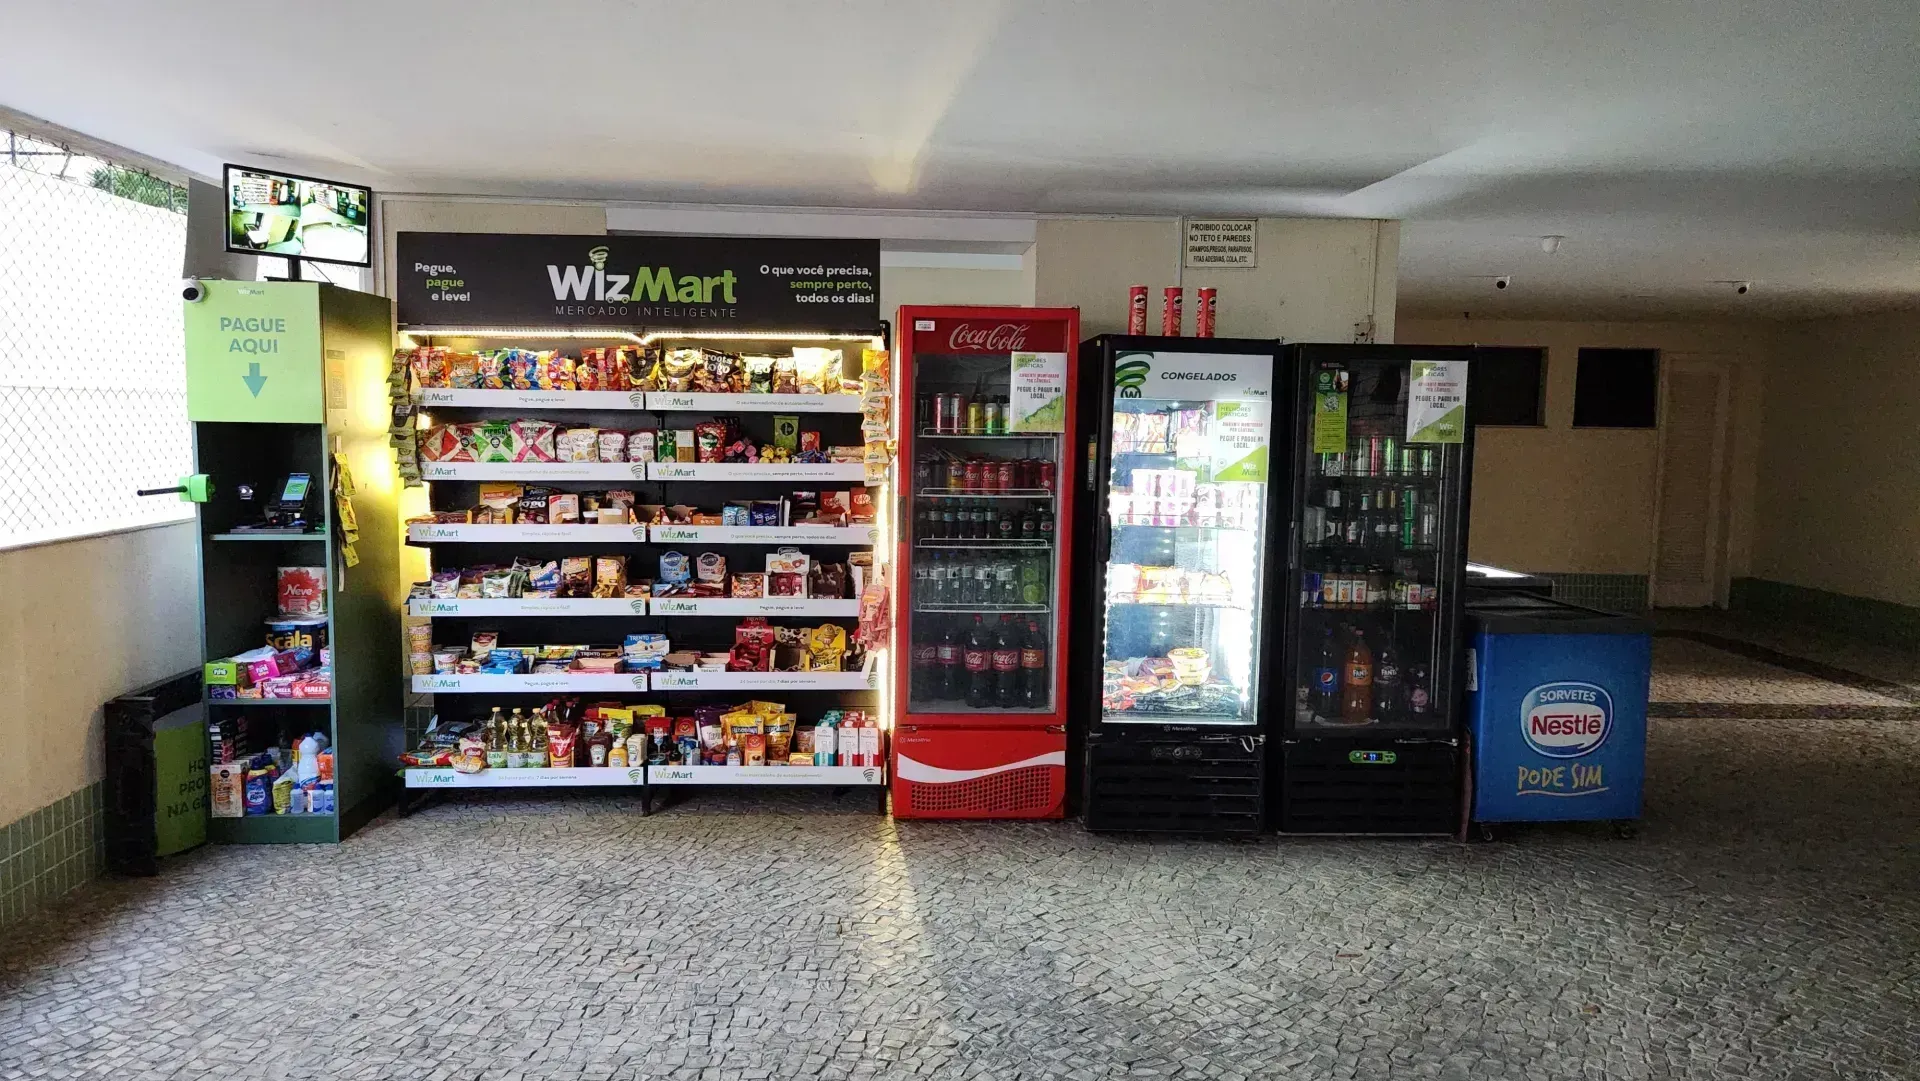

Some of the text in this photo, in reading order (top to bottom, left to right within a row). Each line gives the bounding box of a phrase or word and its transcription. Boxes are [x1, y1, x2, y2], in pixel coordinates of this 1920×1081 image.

[1191, 224, 1252, 232] PROIBIDO COLOCAR
[1222, 235, 1253, 243] PAREDES:
[415, 262, 457, 276] Pegue,
[760, 265, 873, 277] O que você precisa,
[426, 279, 465, 290] pague
[546, 260, 738, 304] WizMart
[790, 281, 872, 291] sempre perto,
[431, 292, 471, 302] e leve!
[796, 293, 875, 303] todos os dias!
[555, 305, 738, 318] MERCADO INTELIGENTE
[220, 317, 286, 333] PAGUE
[949, 323, 1031, 351] Coca-Cola
[229, 338, 278, 355] AQUI
[1161, 371, 1237, 382] CONGELADOS
[1242, 388, 1268, 396] WizMart
[655, 396, 694, 406] WizMart
[1242, 461, 1257, 469] Wiz
[657, 467, 696, 477] WizMart
[419, 527, 459, 537] WizMart
[660, 529, 699, 539] WizMart
[283, 583, 313, 597] Neve
[419, 601, 459, 611] WizMart
[659, 601, 698, 611] WizMart
[266, 630, 313, 650] Scala
[421, 678, 461, 688] WizMart
[661, 676, 699, 686] WizMart
[1540, 690, 1597, 702] SORVETES
[1532, 714, 1602, 735] Nestlé
[415, 773, 456, 783] WizMart
[654, 769, 693, 779] WizMart
[1518, 763, 1603, 790] PODE SIM
[167, 802, 189, 818] NA
